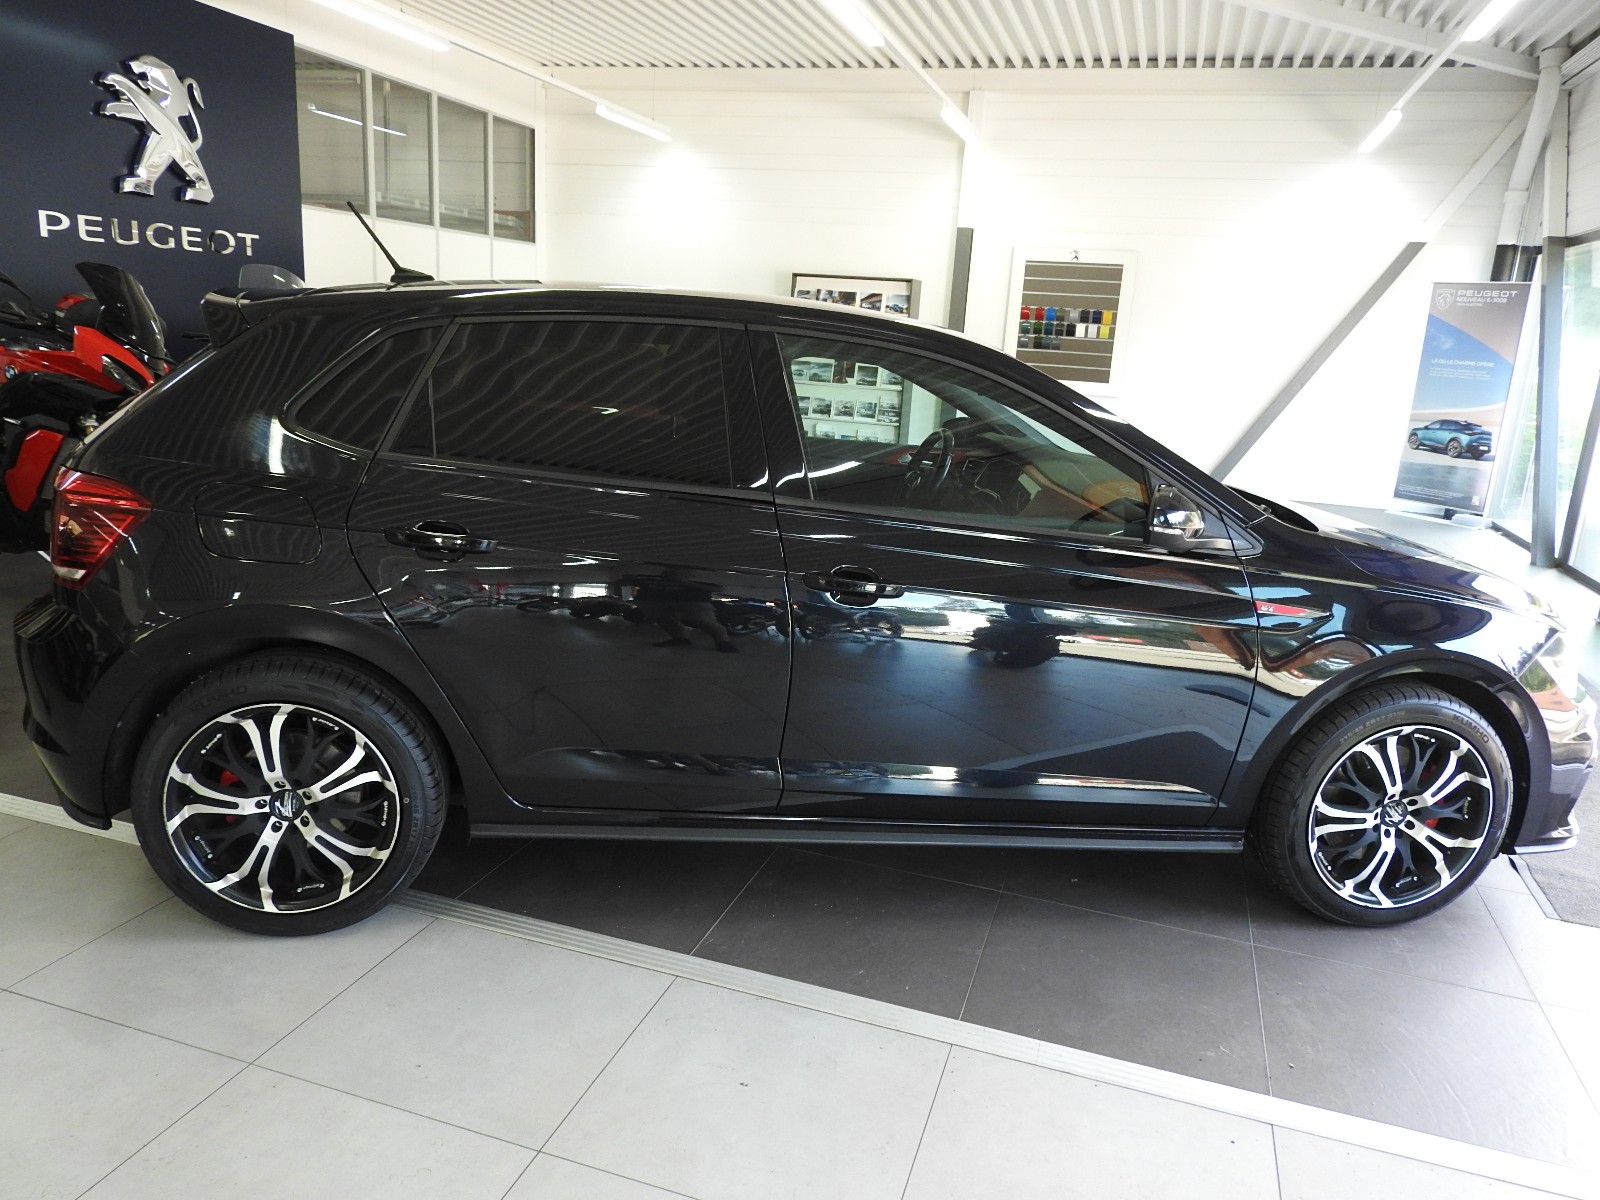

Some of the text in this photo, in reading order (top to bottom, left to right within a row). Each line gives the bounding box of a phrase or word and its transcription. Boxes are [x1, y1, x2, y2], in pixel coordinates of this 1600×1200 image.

[38, 209, 260, 257] PEUGEOT
[190, 686, 248, 713] KUMHO
[1452, 714, 1490, 744] KUMHO
